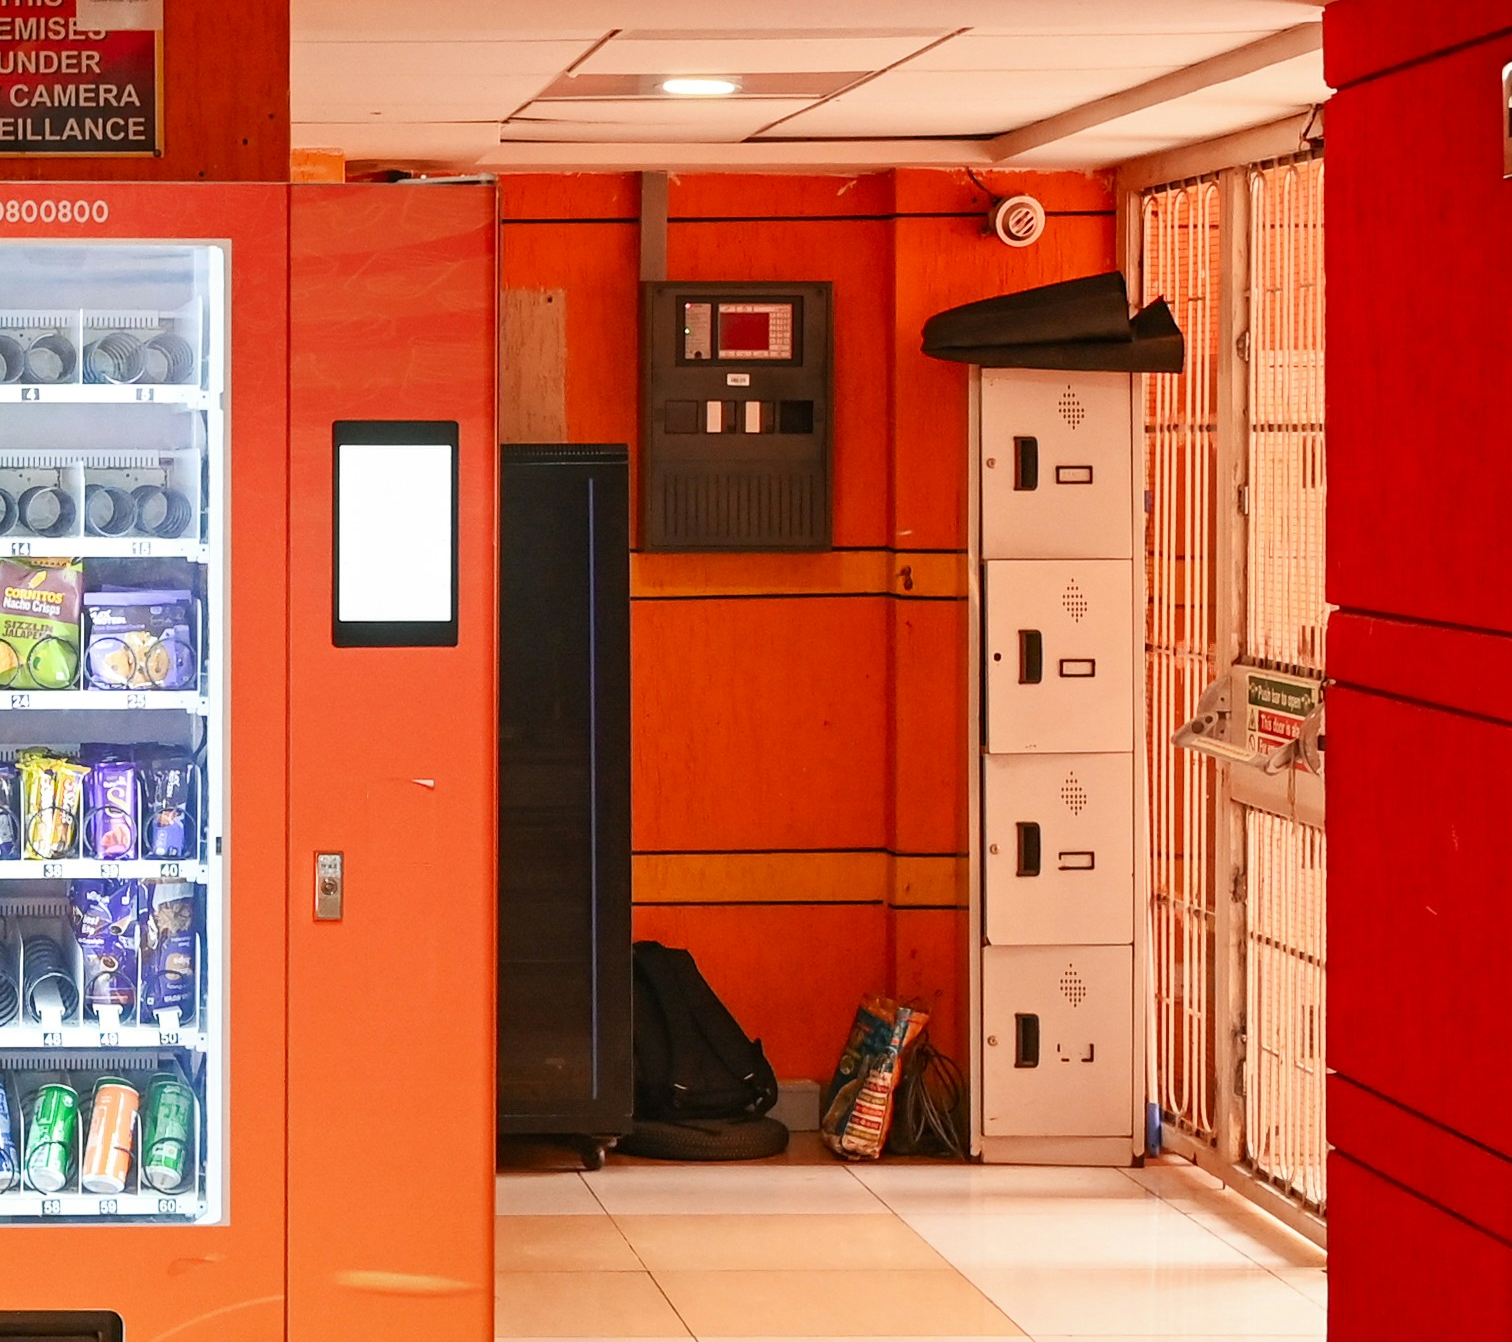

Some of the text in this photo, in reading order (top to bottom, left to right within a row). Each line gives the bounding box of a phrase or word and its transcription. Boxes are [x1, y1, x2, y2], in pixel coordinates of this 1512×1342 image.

[9, 84, 141, 108] CAMERA
[12, 542, 30, 555] 14
[4, 587, 63, 604] CORNITOS
[3, 597, 61, 616] Nacho Crisps
[12, 694, 30, 710] 24
[128, 694, 145, 710] 25
[1258, 685, 1271, 702] Push
[1288, 695, 1302, 712] open
[1261, 713, 1272, 732] This
[1273, 717, 1285, 735] door
[44, 864, 62, 878] 38
[161, 864, 179, 878] 40
[44, 1033, 62, 1047] 48
[100, 1033, 118, 1046] 49
[160, 1033, 178, 1046] 50
[42, 1200, 60, 1215] 58
[100, 1200, 117, 1214] 59
[158, 1199, 176, 1213] 60
